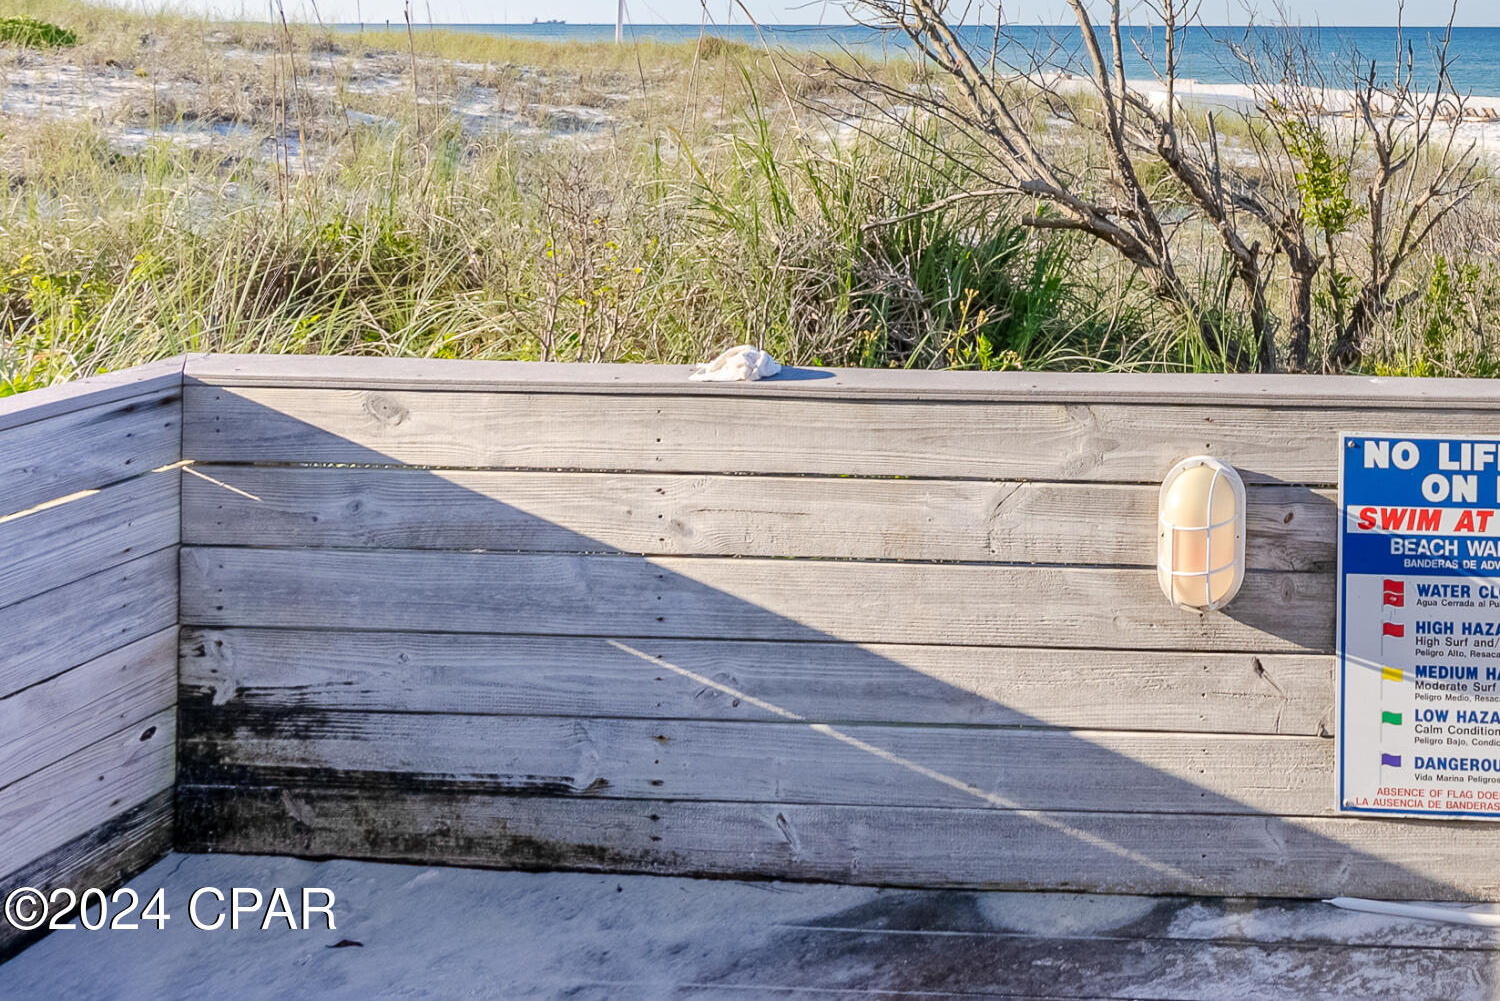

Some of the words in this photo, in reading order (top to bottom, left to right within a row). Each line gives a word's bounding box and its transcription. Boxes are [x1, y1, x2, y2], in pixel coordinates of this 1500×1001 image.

[1363, 441, 1420, 469] NO
[1421, 474, 1478, 503] ON
[1357, 507, 1442, 531] SWIM
[1455, 510, 1494, 533] AT
[1390, 539, 1458, 556] BEACH
[1404, 559, 1458, 569] BANDERAS
[1463, 560, 1476, 569] DE
[1417, 584, 1470, 598] WATER
[1417, 599, 1438, 607] Agua
[1416, 621, 1454, 635] HIGH
[1416, 636, 1439, 648] High
[1445, 637, 1468, 647] Surf
[1415, 649, 1444, 658] Peligro
[1448, 650, 1466, 658] Alto,
[1470, 650, 1500, 658] Resaca
[1415, 665, 1478, 679] MEDIUM
[1415, 681, 1468, 691] Moderate
[1473, 682, 1496, 692] Surf
[1415, 693, 1442, 701] Peligro
[1445, 694, 1471, 702] Medio,
[1415, 709, 1448, 722] LOW
[1415, 725, 1442, 734] Calm
[1415, 737, 1443, 746] Peligro
[1447, 738, 1468, 746] Bajo,
[1377, 787, 1424, 797] ABSENCE
[1430, 789, 1443, 798] OF
[1448, 790, 1472, 799] FLAG
[1356, 797, 1368, 806] LA
[1373, 798, 1423, 808] AUSENCIA
[1428, 800, 1442, 809] DE
[1446, 800, 1500, 810] BANDERAS
